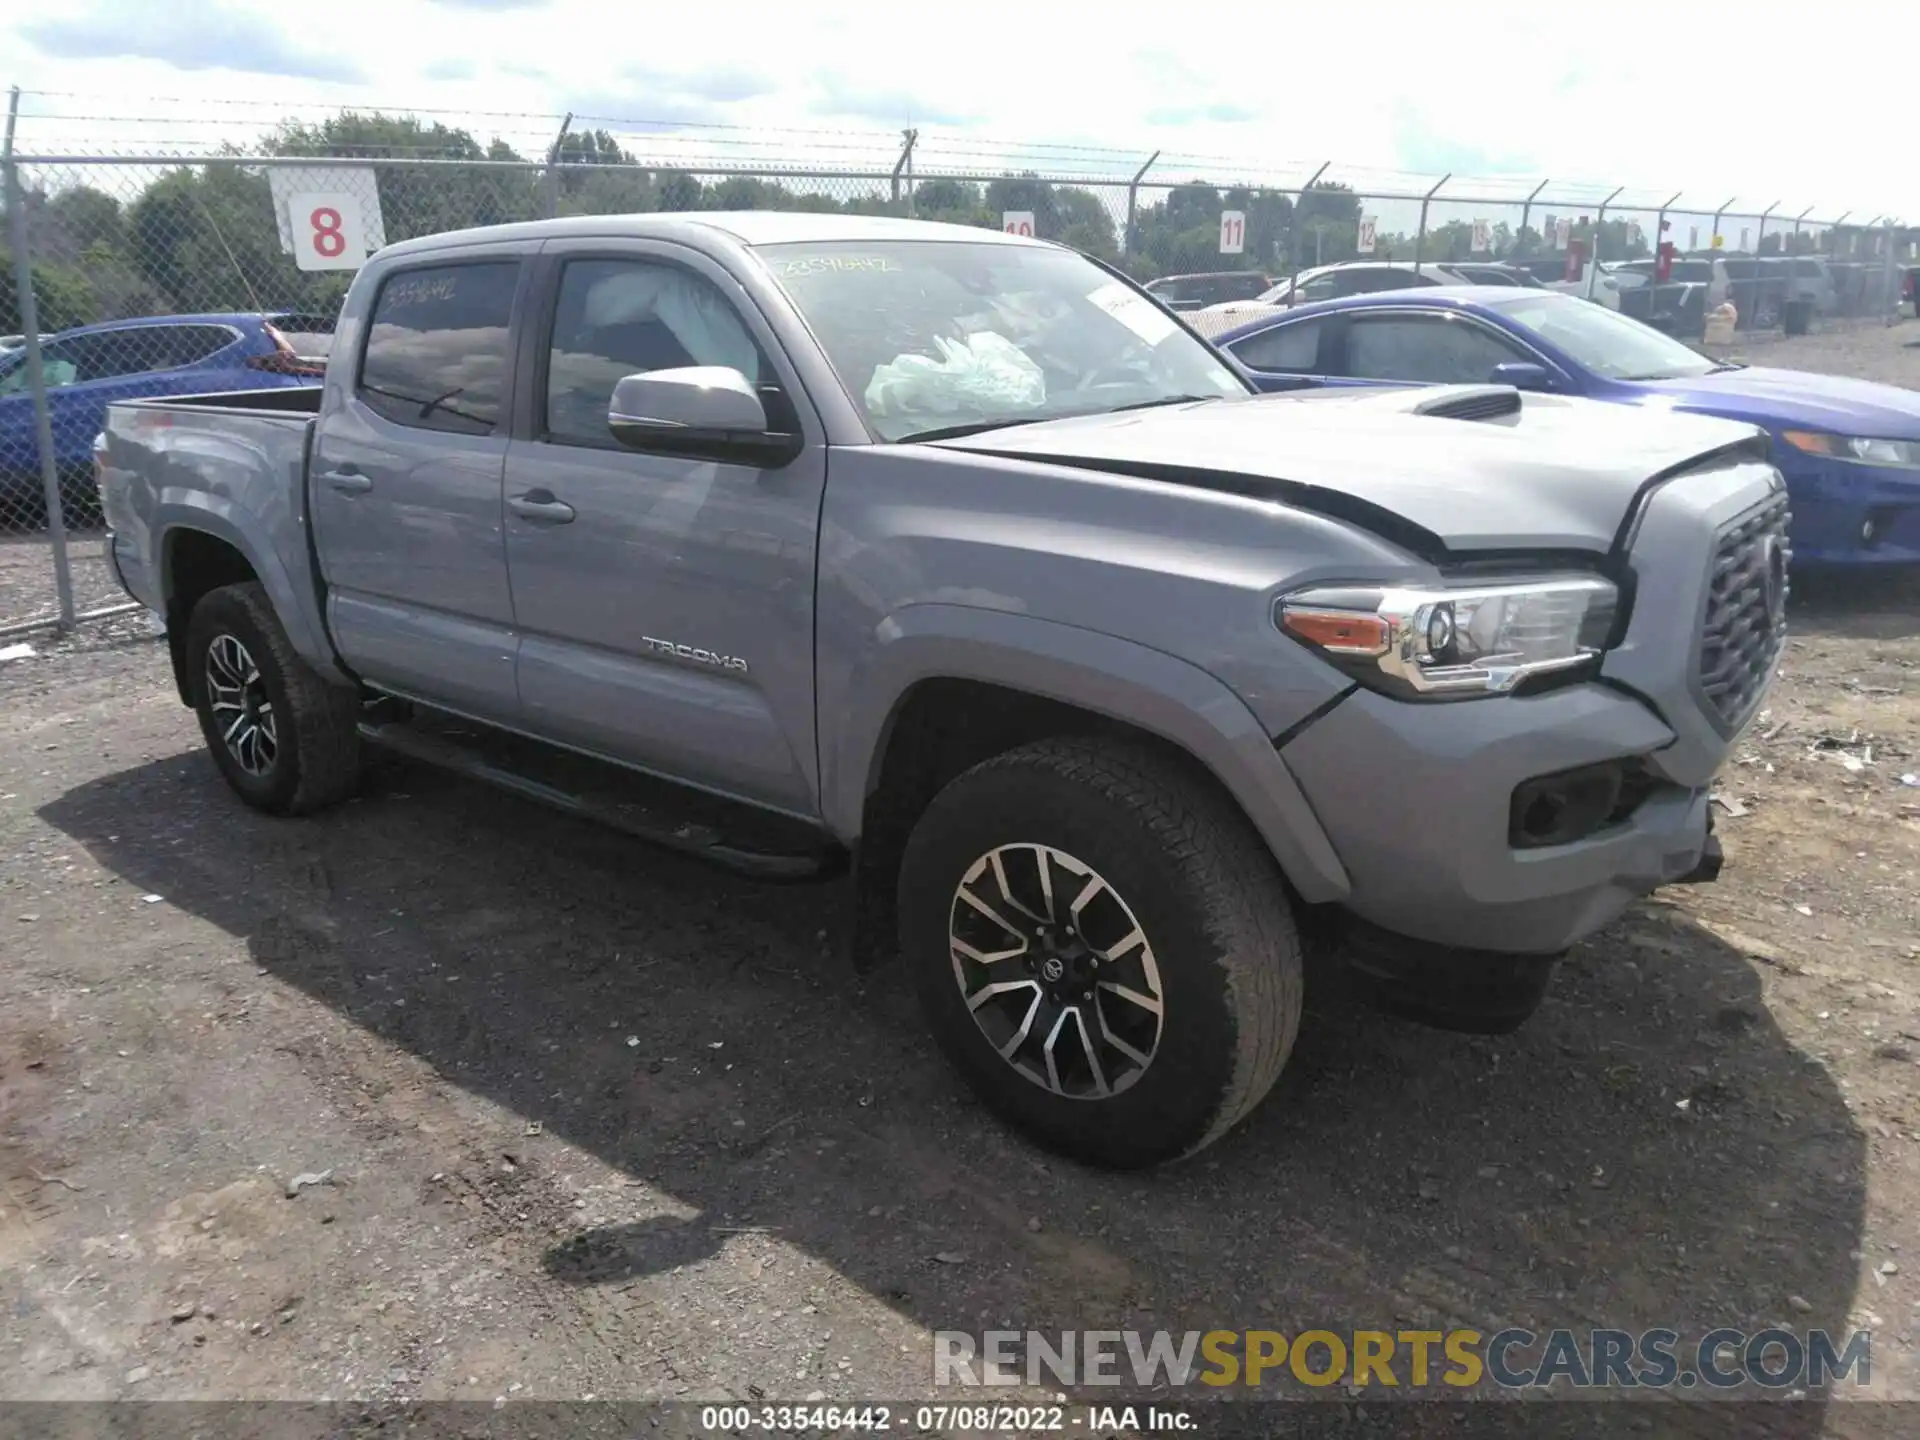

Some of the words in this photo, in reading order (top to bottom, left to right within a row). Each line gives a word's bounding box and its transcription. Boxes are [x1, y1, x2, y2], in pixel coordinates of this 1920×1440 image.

[310, 207, 346, 257] 8
[1223, 218, 1242, 246] 11
[1360, 223, 1375, 247] 12
[641, 636, 748, 672] TACOMA
